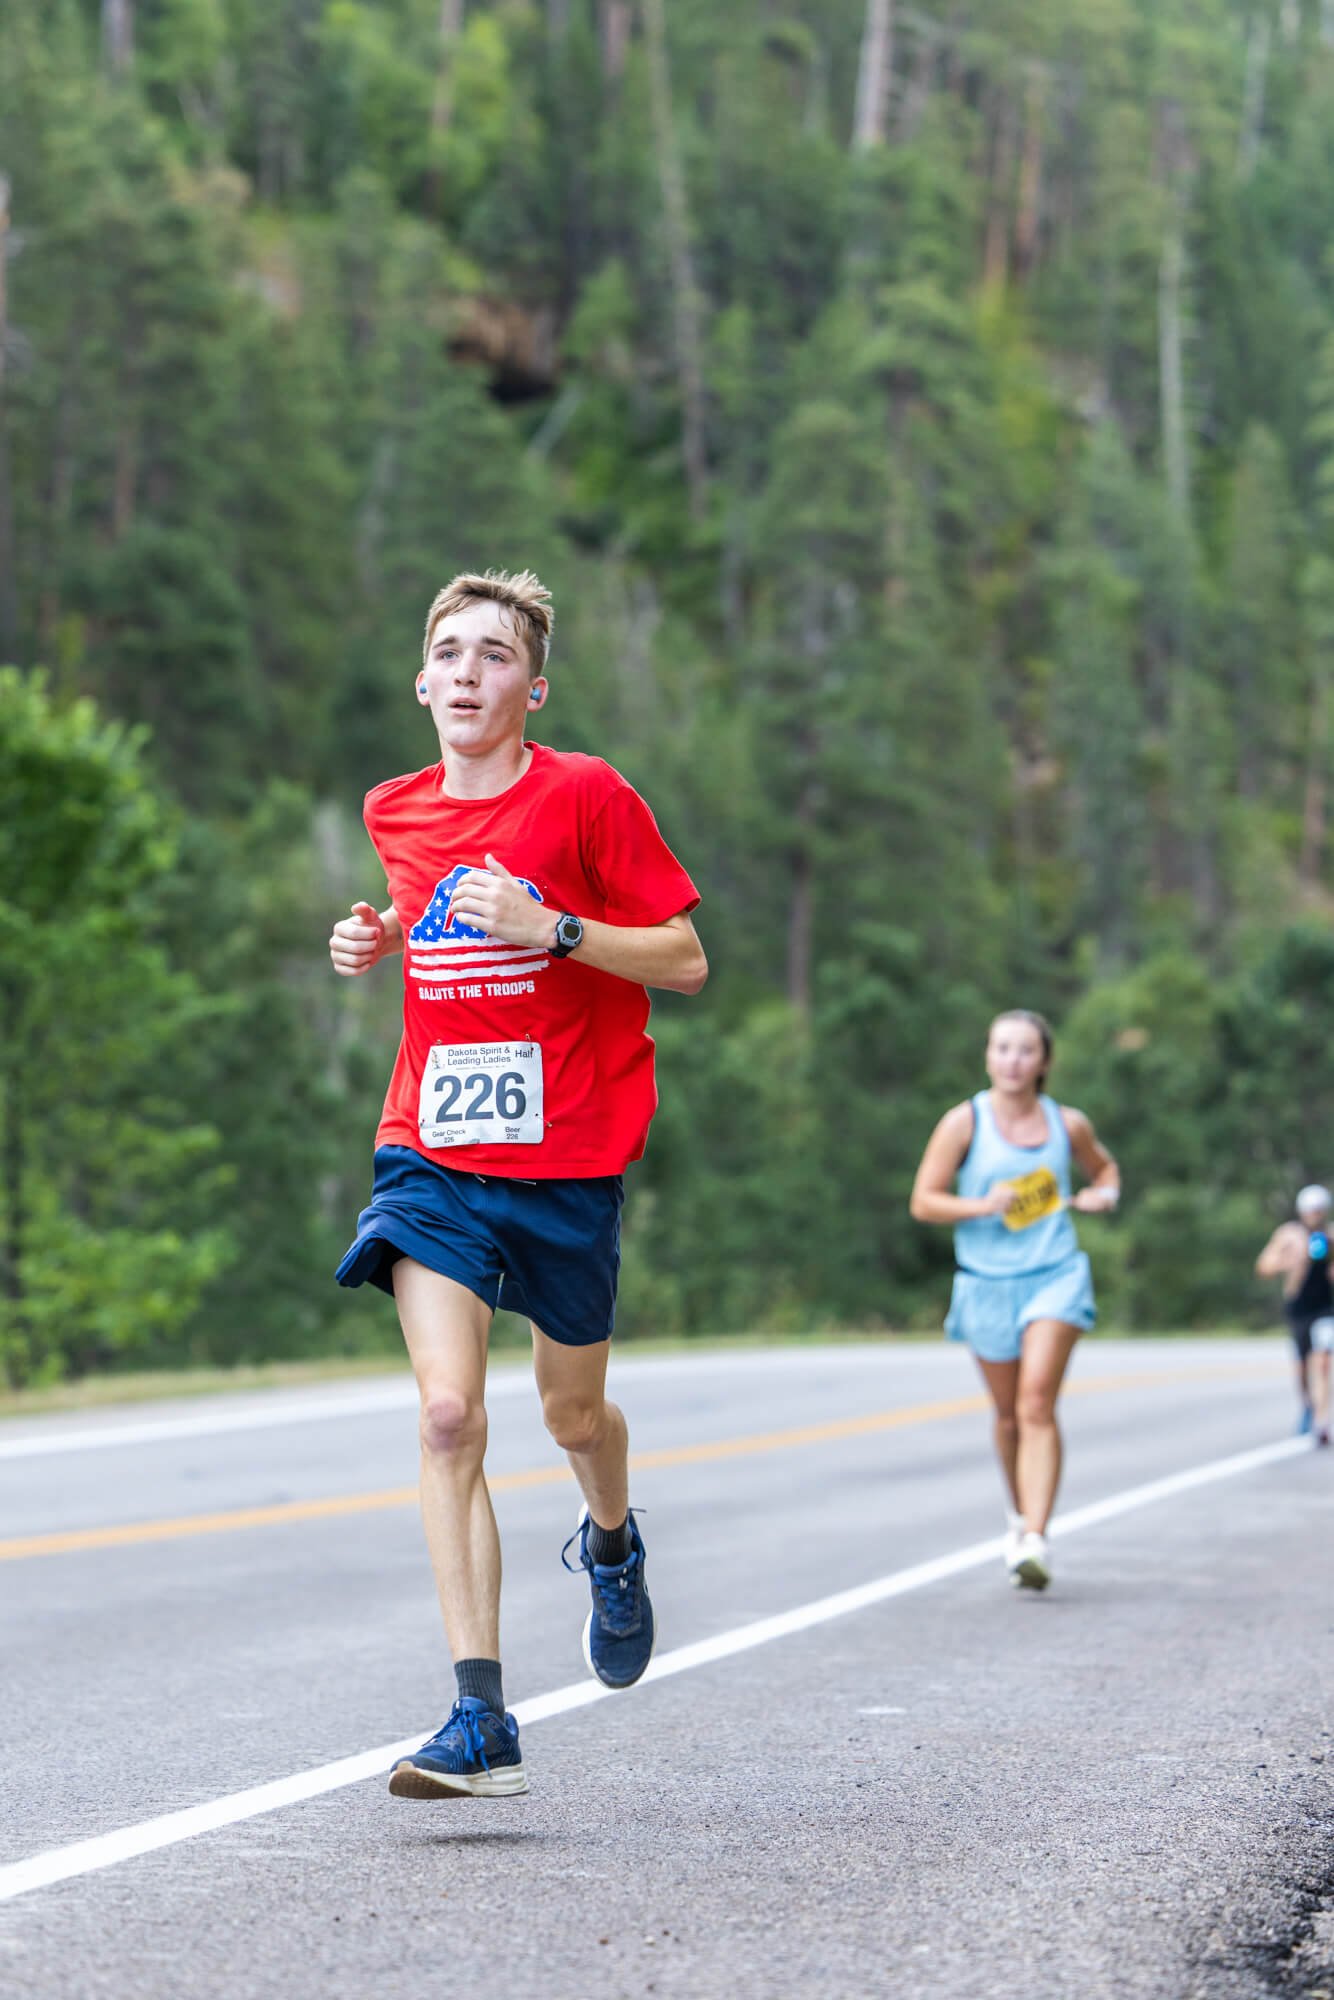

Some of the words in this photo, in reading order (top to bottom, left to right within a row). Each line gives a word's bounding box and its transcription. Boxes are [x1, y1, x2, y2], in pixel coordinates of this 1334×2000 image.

[418, 986, 455, 1001] SALUTE
[457, 984, 482, 999] THE
[485, 980, 535, 996] TROOPS
[447, 1048, 478, 1057] Dakota
[480, 1047, 502, 1056] Spirit
[504, 1046, 511, 1054] &
[515, 1048, 533, 1058] Half
[447, 1057, 481, 1066] Leading
[483, 1055, 511, 1064] Ladies
[434, 1071, 527, 1123] 226
[432, 1130, 445, 1138] Gear
